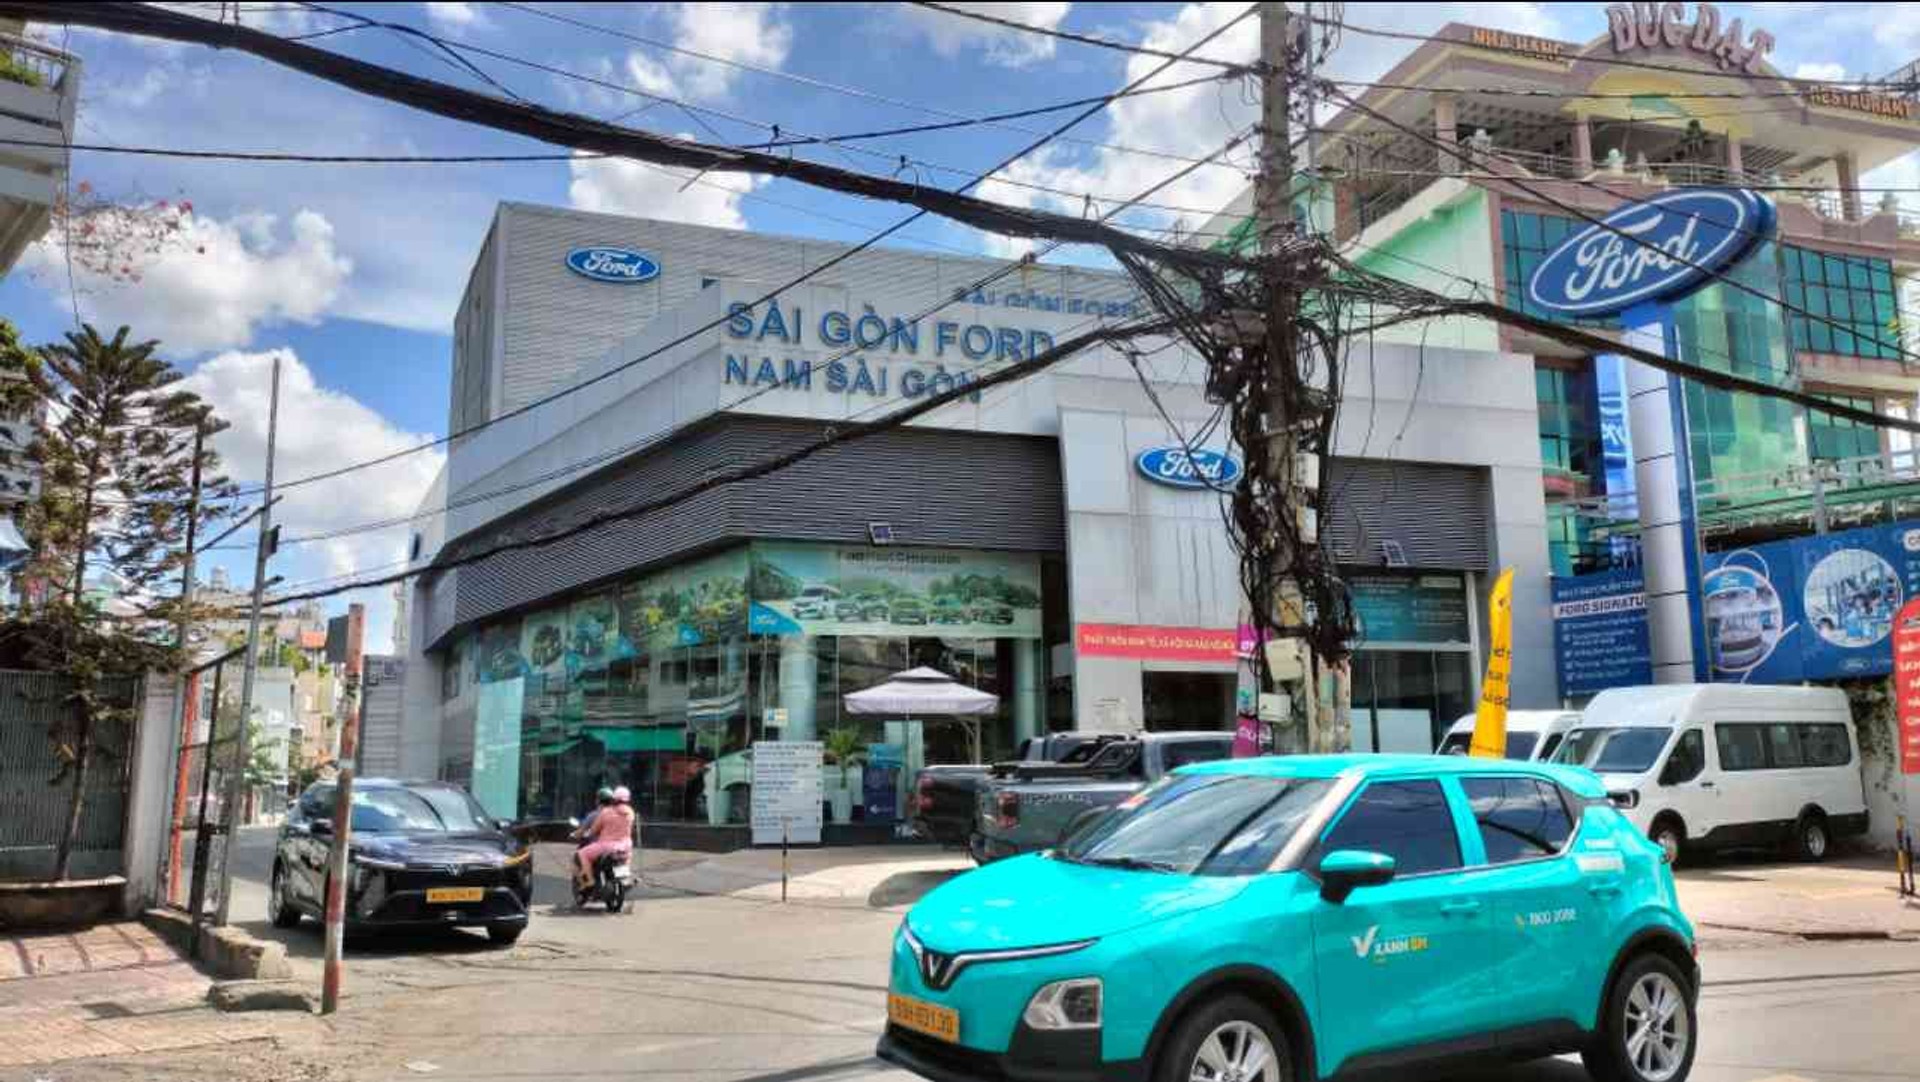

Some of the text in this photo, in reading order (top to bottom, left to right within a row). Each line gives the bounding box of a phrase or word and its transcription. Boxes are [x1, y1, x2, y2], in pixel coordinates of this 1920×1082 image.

[582, 250, 643, 275] Ford
[1565, 213, 1699, 300] Ford
[729, 300, 1053, 363] SÀI GÒN FORD
[724, 353, 812, 390] NAM
[825, 359, 887, 397] SÀI
[1160, 450, 1224, 479] Ford
